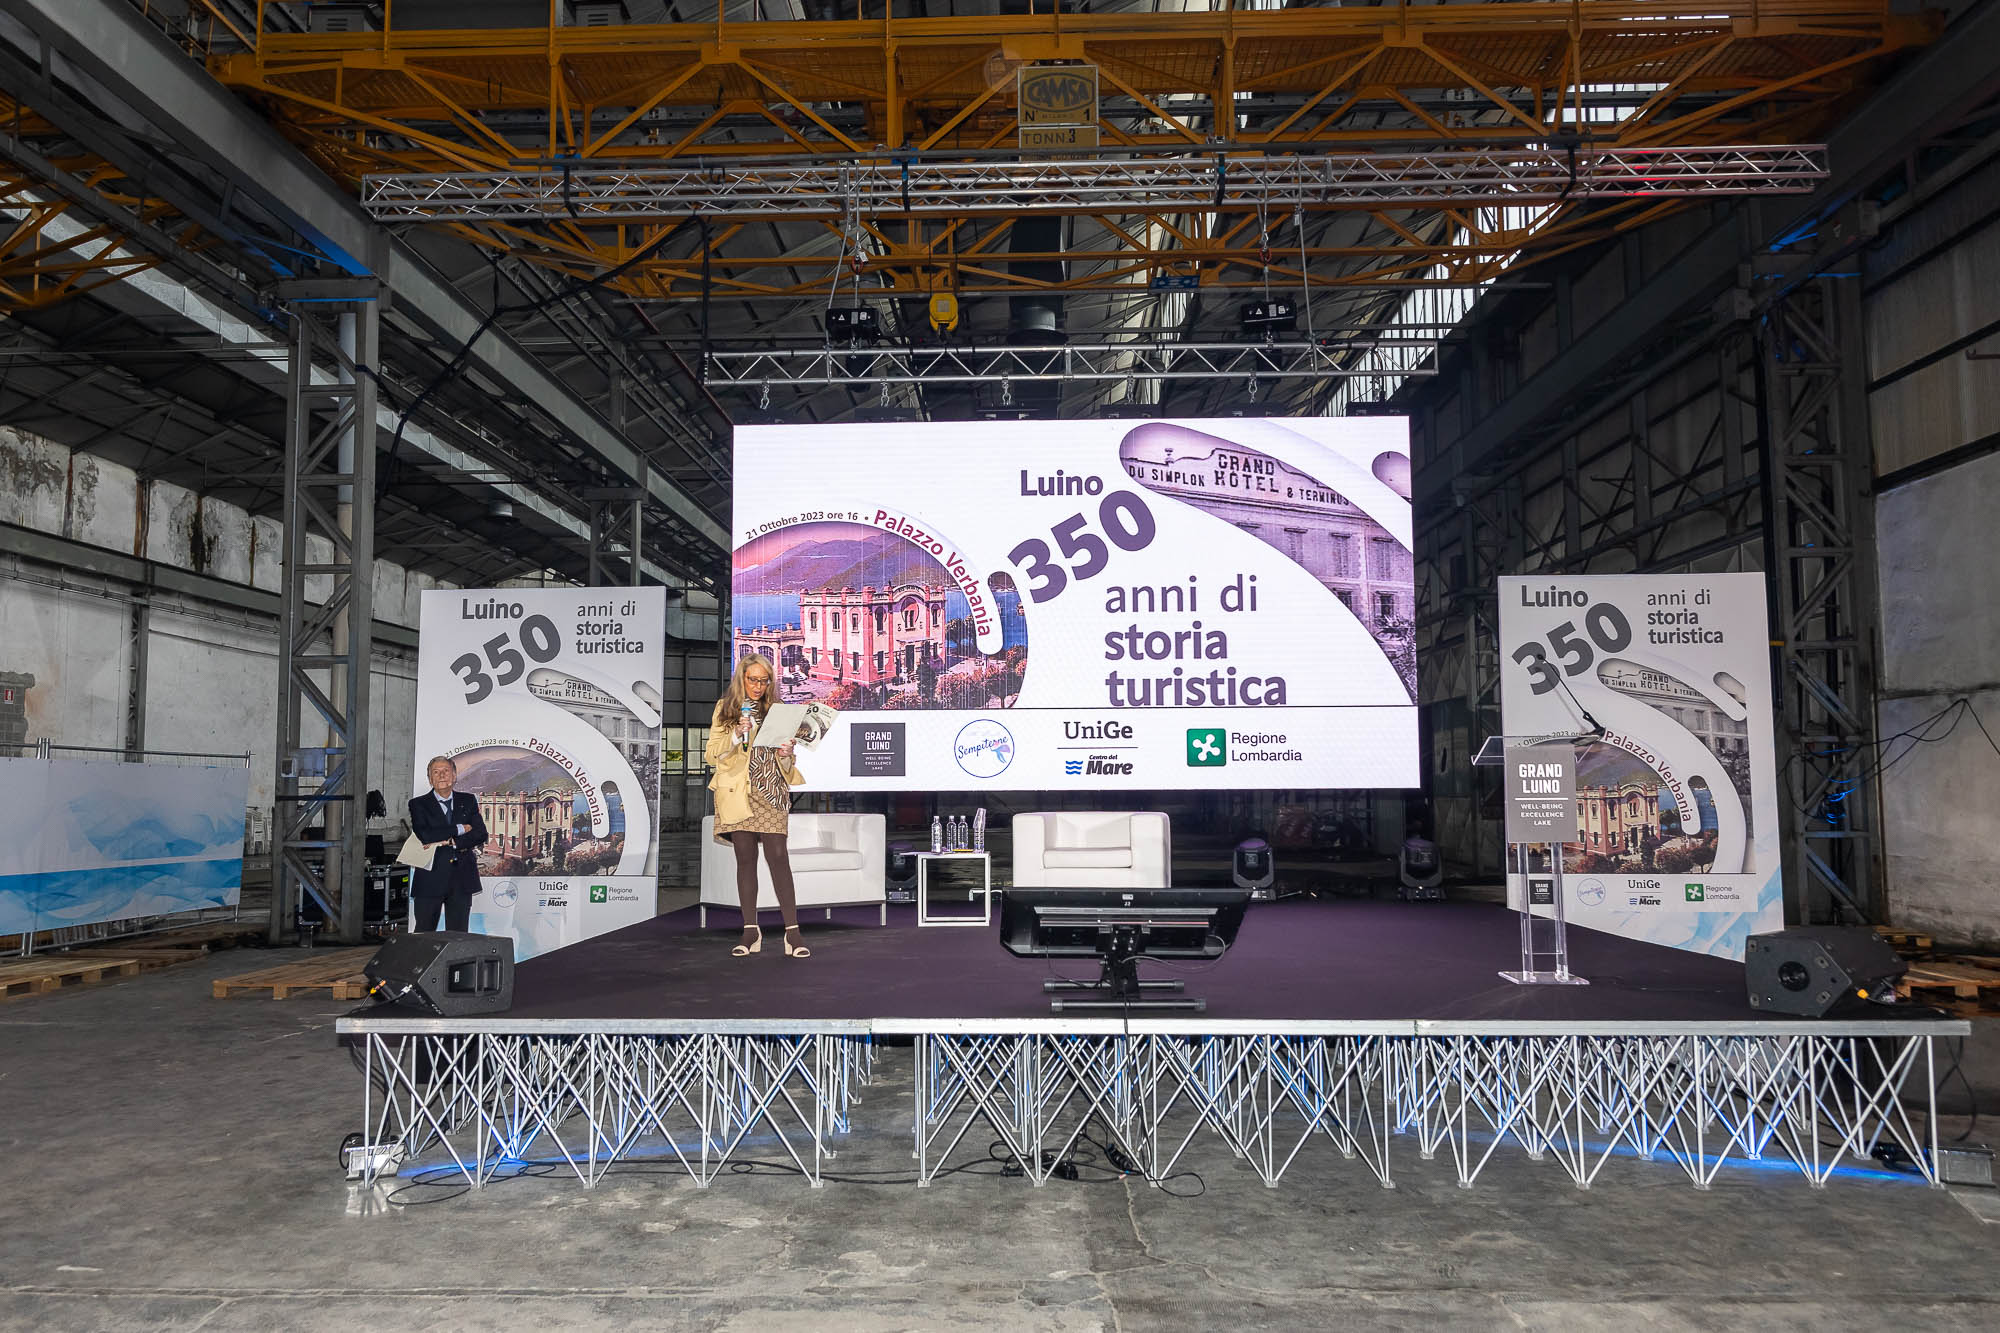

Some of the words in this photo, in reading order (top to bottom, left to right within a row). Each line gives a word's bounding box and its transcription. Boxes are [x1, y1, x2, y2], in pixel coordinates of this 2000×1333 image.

[1028, 78, 1089, 107] CAMSA
[1083, 108, 1090, 121] 1
[1068, 128, 1076, 143] 3
[1218, 454, 1274, 475] GRAND
[1020, 469, 1103, 496] Luino
[1129, 465, 1144, 478] DU
[1152, 469, 1205, 487] SIMPLON
[1287, 487, 1294, 498] &
[1007, 490, 1156, 603] 350
[745, 528, 758, 540] 21
[760, 515, 798, 533] Ottobre
[800, 511, 824, 521] 2023
[847, 512, 858, 521] 16
[874, 509, 944, 556] Palazzo
[946, 552, 990, 636] Verbania
[1105, 575, 1197, 613] anni
[1220, 574, 1257, 612] di
[1521, 585, 1589, 607] Luino
[1647, 589, 1686, 606] anni
[1694, 589, 1710, 605] di
[462, 598, 524, 620] Luino
[577, 601, 613, 617] anni
[621, 600, 636, 616] di
[1647, 608, 1699, 625] storia
[576, 620, 623, 635] storia
[1648, 627, 1724, 645] turistica
[576, 637, 644, 654] turistica
[1105, 621, 1228, 660] storia
[1511, 602, 1632, 696] 350
[450, 614, 561, 705] 350
[567, 681, 592, 691] GRAND
[1641, 672, 1669, 683] GRAND
[1105, 667, 1287, 706] turistica
[865, 731, 892, 740] GRAND
[1063, 720, 1133, 739] UniGe
[866, 741, 890, 750] LUINO
[1231, 732, 1287, 746] Regione
[1231, 749, 1302, 761] Lombardia
[1086, 760, 1133, 775] Mare
[1519, 763, 1563, 778] GRAND
[1552, 731, 1568, 739] 2023
[1604, 730, 1655, 764] Palazzo
[1657, 760, 1691, 822] Verbania
[455, 742, 480, 754] Ottobre
[481, 738, 497, 746] 2023
[528, 737, 574, 770] Palazzo
[574, 766, 602, 826] Verbania
[1522, 779, 1560, 793] LUINO
[539, 881, 569, 891] UniGe
[609, 887, 633, 895] Regione
[1627, 879, 1661, 889] UniGe
[1706, 885, 1733, 893] Regione
[547, 899, 568, 907] Mare
[1638, 897, 1661, 906] Mare
